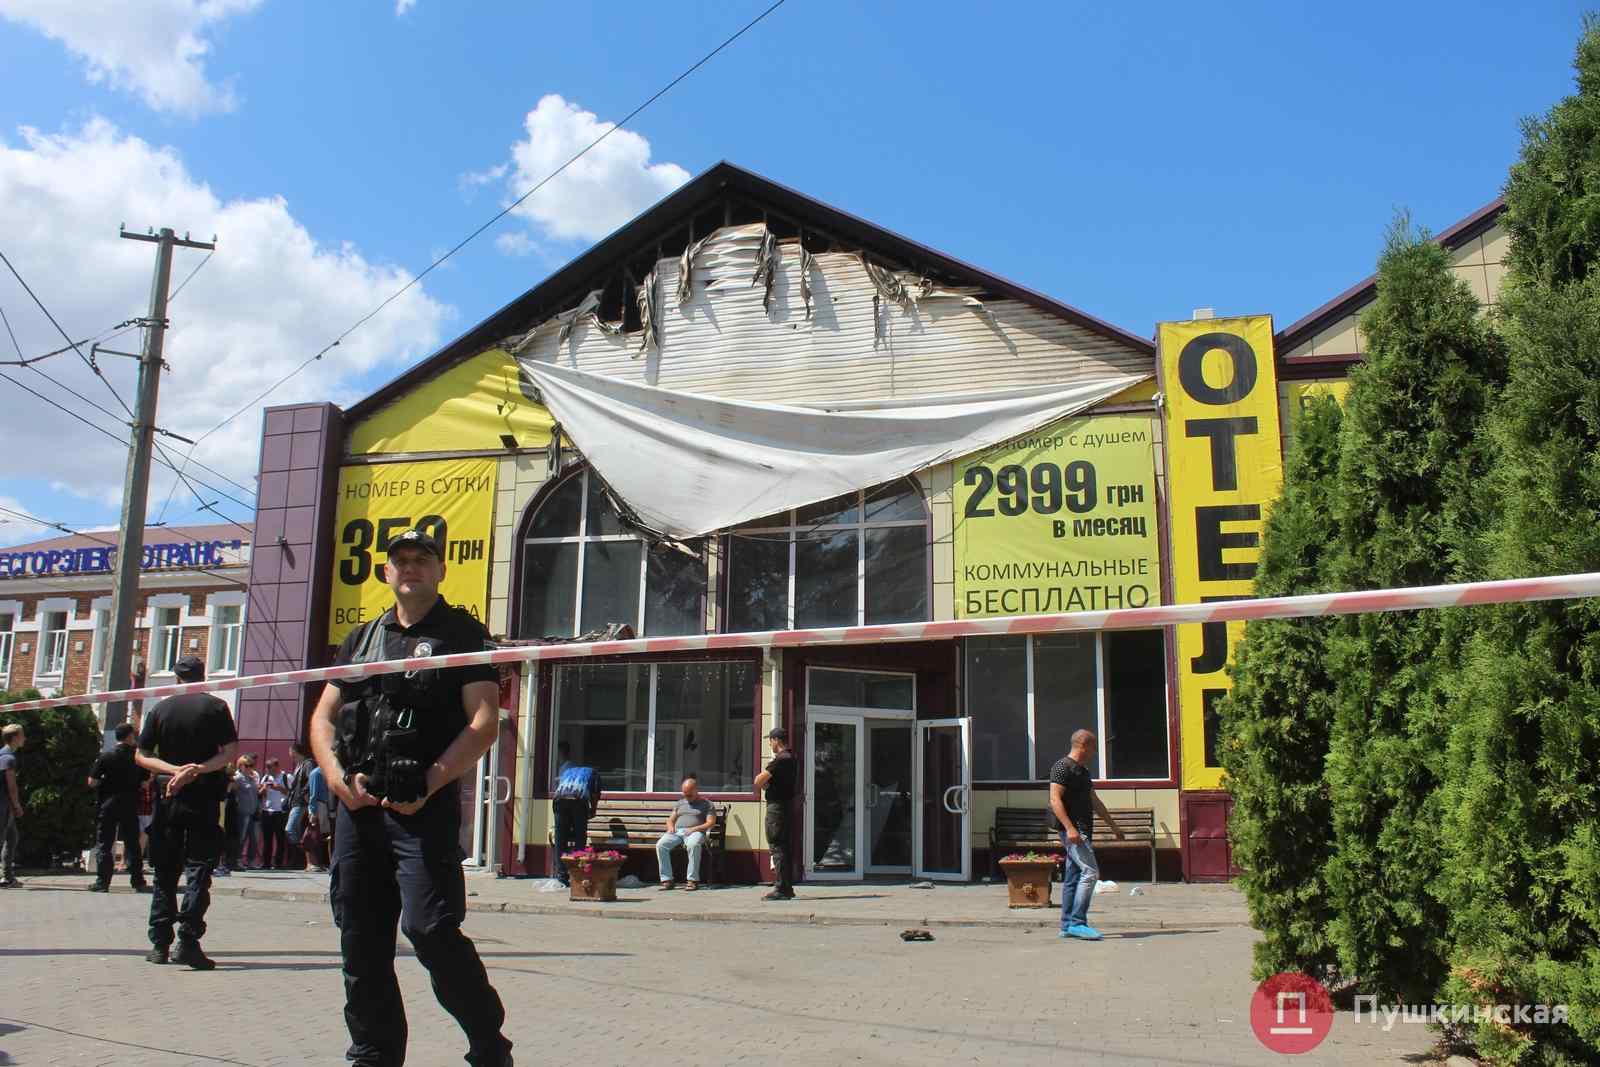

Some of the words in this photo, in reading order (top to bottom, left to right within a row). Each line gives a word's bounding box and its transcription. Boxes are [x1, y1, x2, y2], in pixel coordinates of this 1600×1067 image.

[1069, 435, 1078, 446] с
[1083, 431, 1146, 448] душем
[345, 480, 410, 499] НОМЕР
[415, 480, 425, 495] В
[431, 475, 490, 495] СУТКИ
[963, 460, 1098, 519] 2999
[1107, 485, 1144, 507] грн
[1053, 520, 1066, 538] в
[1073, 517, 1147, 538] месяц
[449, 539, 484, 564] грн
[965, 558, 1149, 581] КОММУНАЛЬНЫЕ
[966, 584, 1150, 614] БЕСПЛАТНО
[335, 607, 367, 625] ВСЕ
